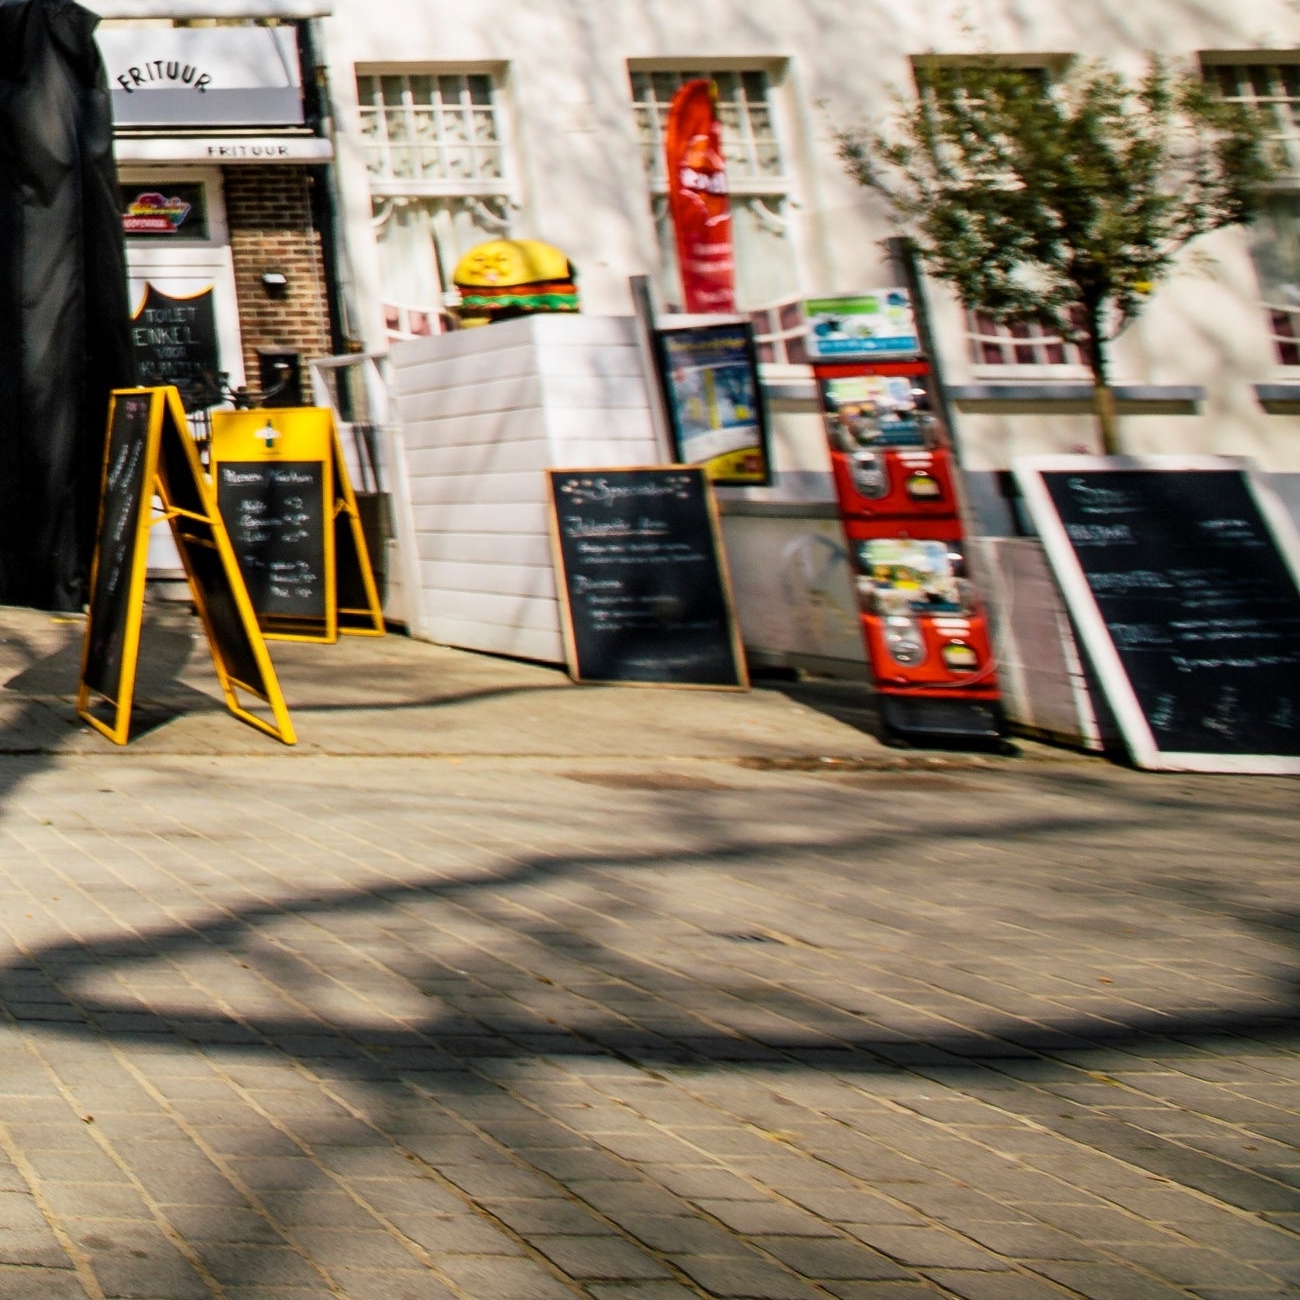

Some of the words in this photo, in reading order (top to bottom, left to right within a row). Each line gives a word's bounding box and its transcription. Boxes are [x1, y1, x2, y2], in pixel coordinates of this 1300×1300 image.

[117, 60, 212, 93] FRITUUR
[207, 146, 289, 156] FRITUUR
[132, 327, 199, 347] ENKEL
